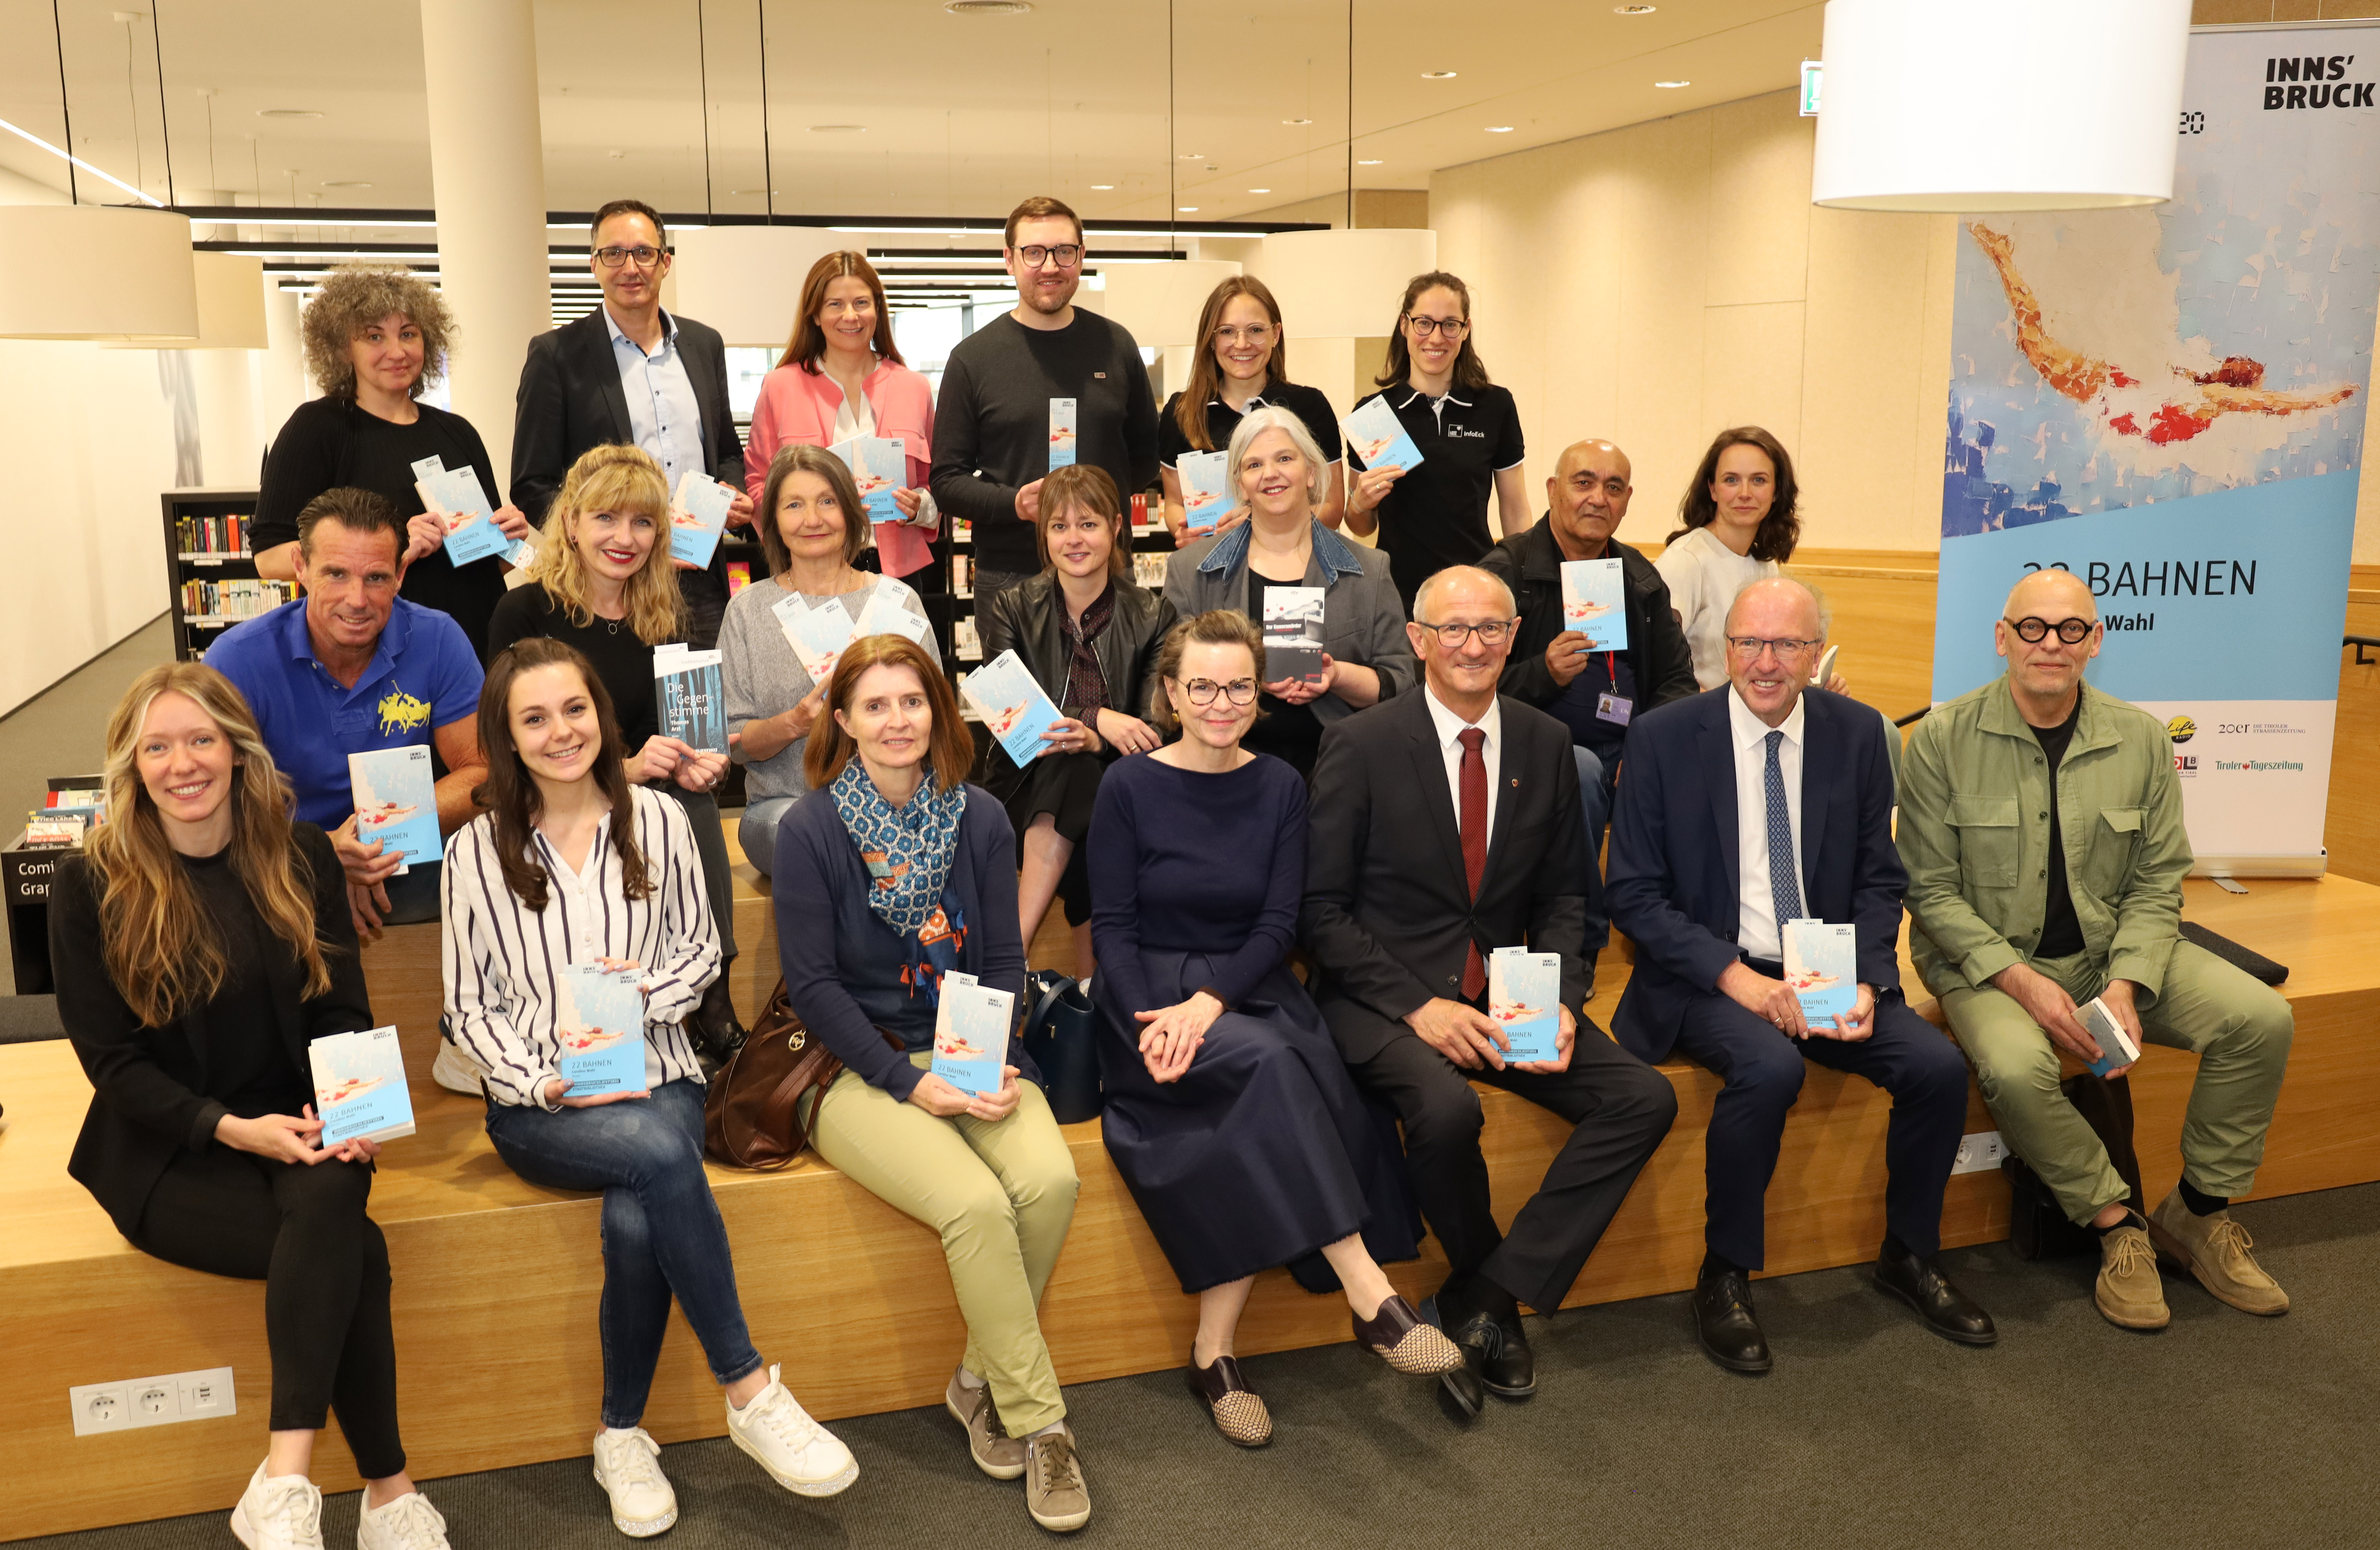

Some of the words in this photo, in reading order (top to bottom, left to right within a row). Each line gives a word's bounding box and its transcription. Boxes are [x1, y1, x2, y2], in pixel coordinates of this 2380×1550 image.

[2266, 55, 2355, 82] INNS'
[2264, 83, 2376, 110] BRUCK
[459, 532, 479, 542] BAHNEN
[674, 532, 693, 542] BAHNEN
[2088, 560, 2256, 596] BAHNEN
[827, 604, 840, 613] BRUCK
[910, 620, 923, 629] BRUCK
[2105, 612, 2154, 631] Wahl
[667, 682, 684, 694] Die
[677, 694, 714, 706] Gegen-
[670, 706, 709, 717] stimme
[1015, 723, 1035, 741] BAHNEN
[2167, 721, 2197, 735] Life
[2218, 724, 2250, 733] 20er
[2215, 761, 2242, 770] Tiroler
[2249, 760, 2303, 771] Tageszeitung
[583, 1059, 612, 1068] BAHNEN
[947, 1066, 971, 1077] BAHNEN
[330, 1111, 339, 1119] 22
[341, 1102, 372, 1115] BAHNEN
